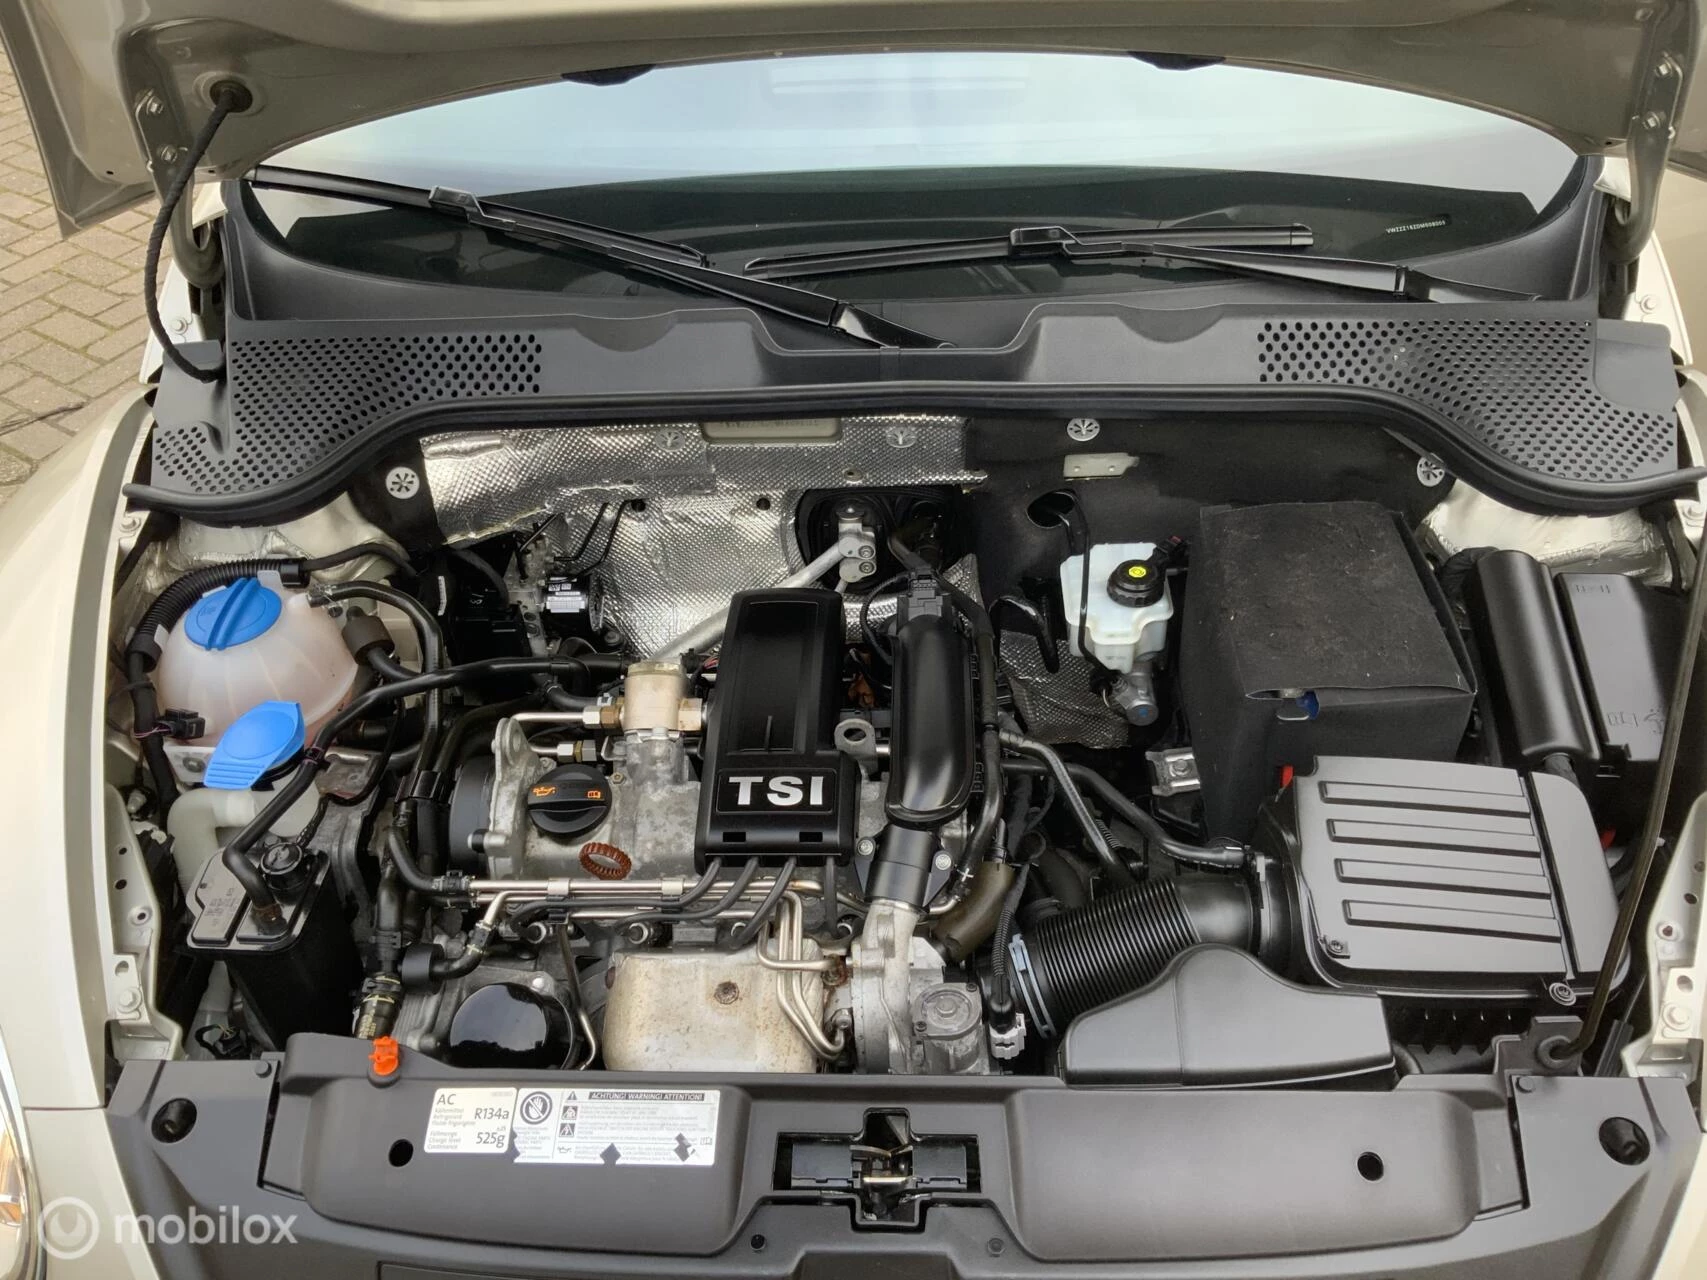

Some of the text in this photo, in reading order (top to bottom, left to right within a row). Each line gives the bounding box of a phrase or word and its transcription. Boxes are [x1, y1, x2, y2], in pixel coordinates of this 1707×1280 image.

[728, 775, 824, 807] TSI
[436, 1093, 457, 1105] AC
[591, 1092, 626, 1100] ACHTUNG!
[664, 1093, 703, 1101] ATTENTION!
[474, 1107, 510, 1120] R134a
[475, 1131, 506, 1149] 525g
